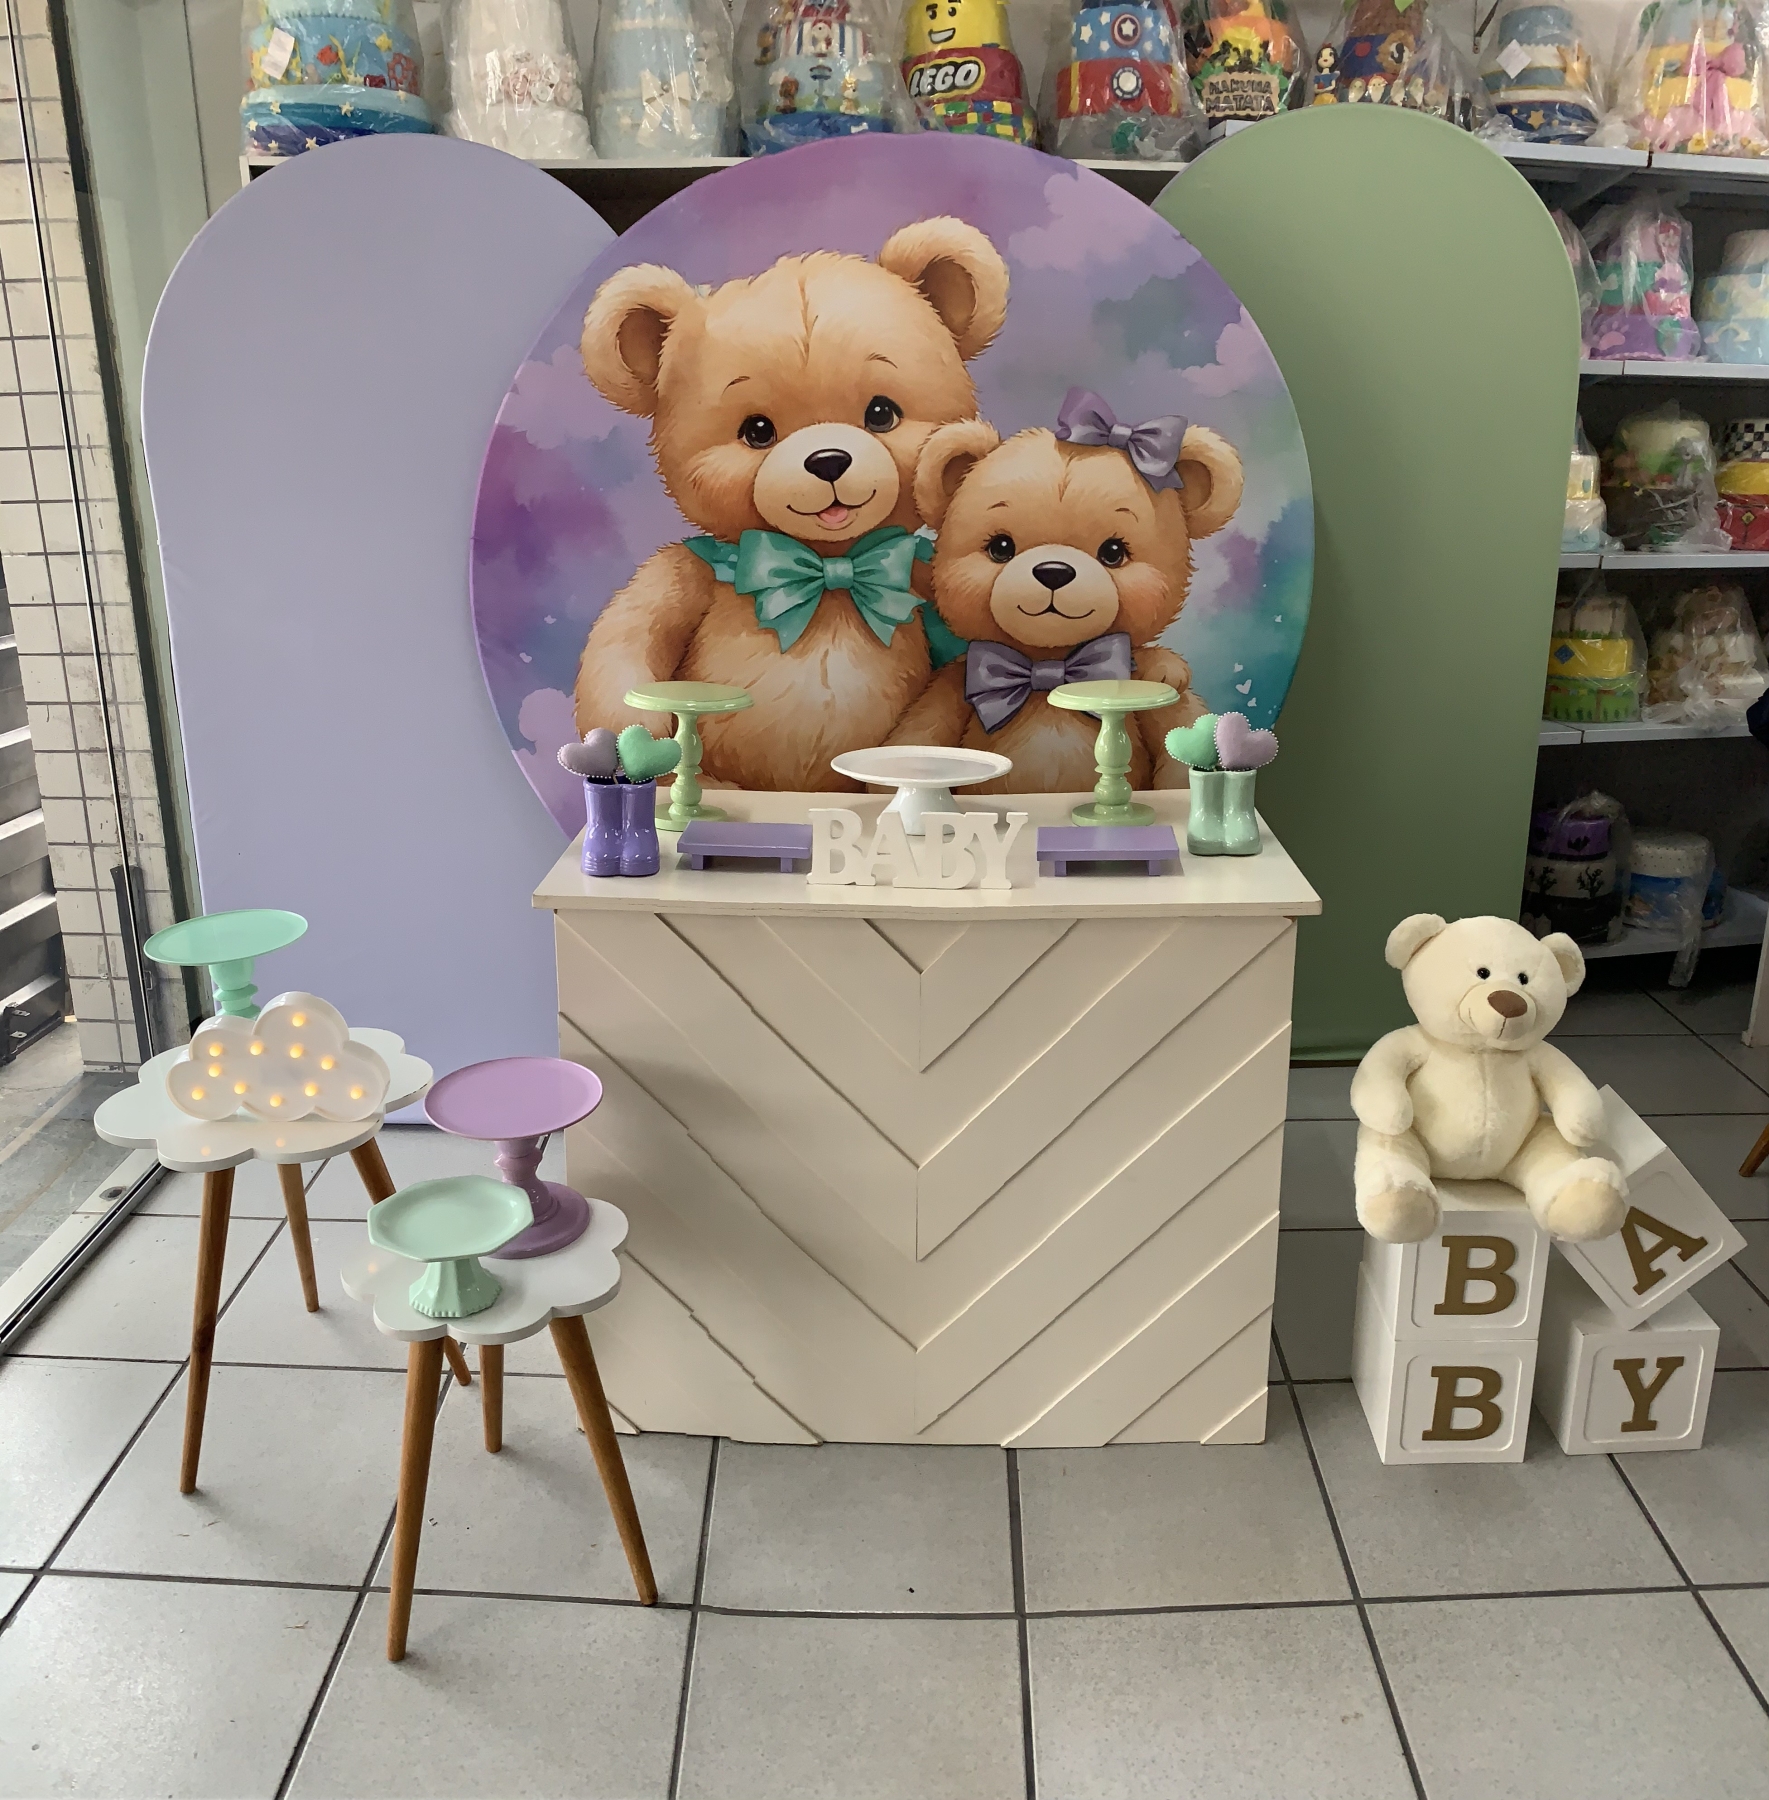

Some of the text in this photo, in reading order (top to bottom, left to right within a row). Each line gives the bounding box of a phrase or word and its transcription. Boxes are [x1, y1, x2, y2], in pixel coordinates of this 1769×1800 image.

[910, 63, 979, 97] LEGO
[1205, 95, 1275, 113] MATATA
[806, 808, 1029, 889] BABY
[1434, 1235, 1516, 1315] B
[1620, 1206, 1708, 1295] A
[1421, 1365, 1503, 1441] B
[1613, 1356, 1684, 1432] Y
